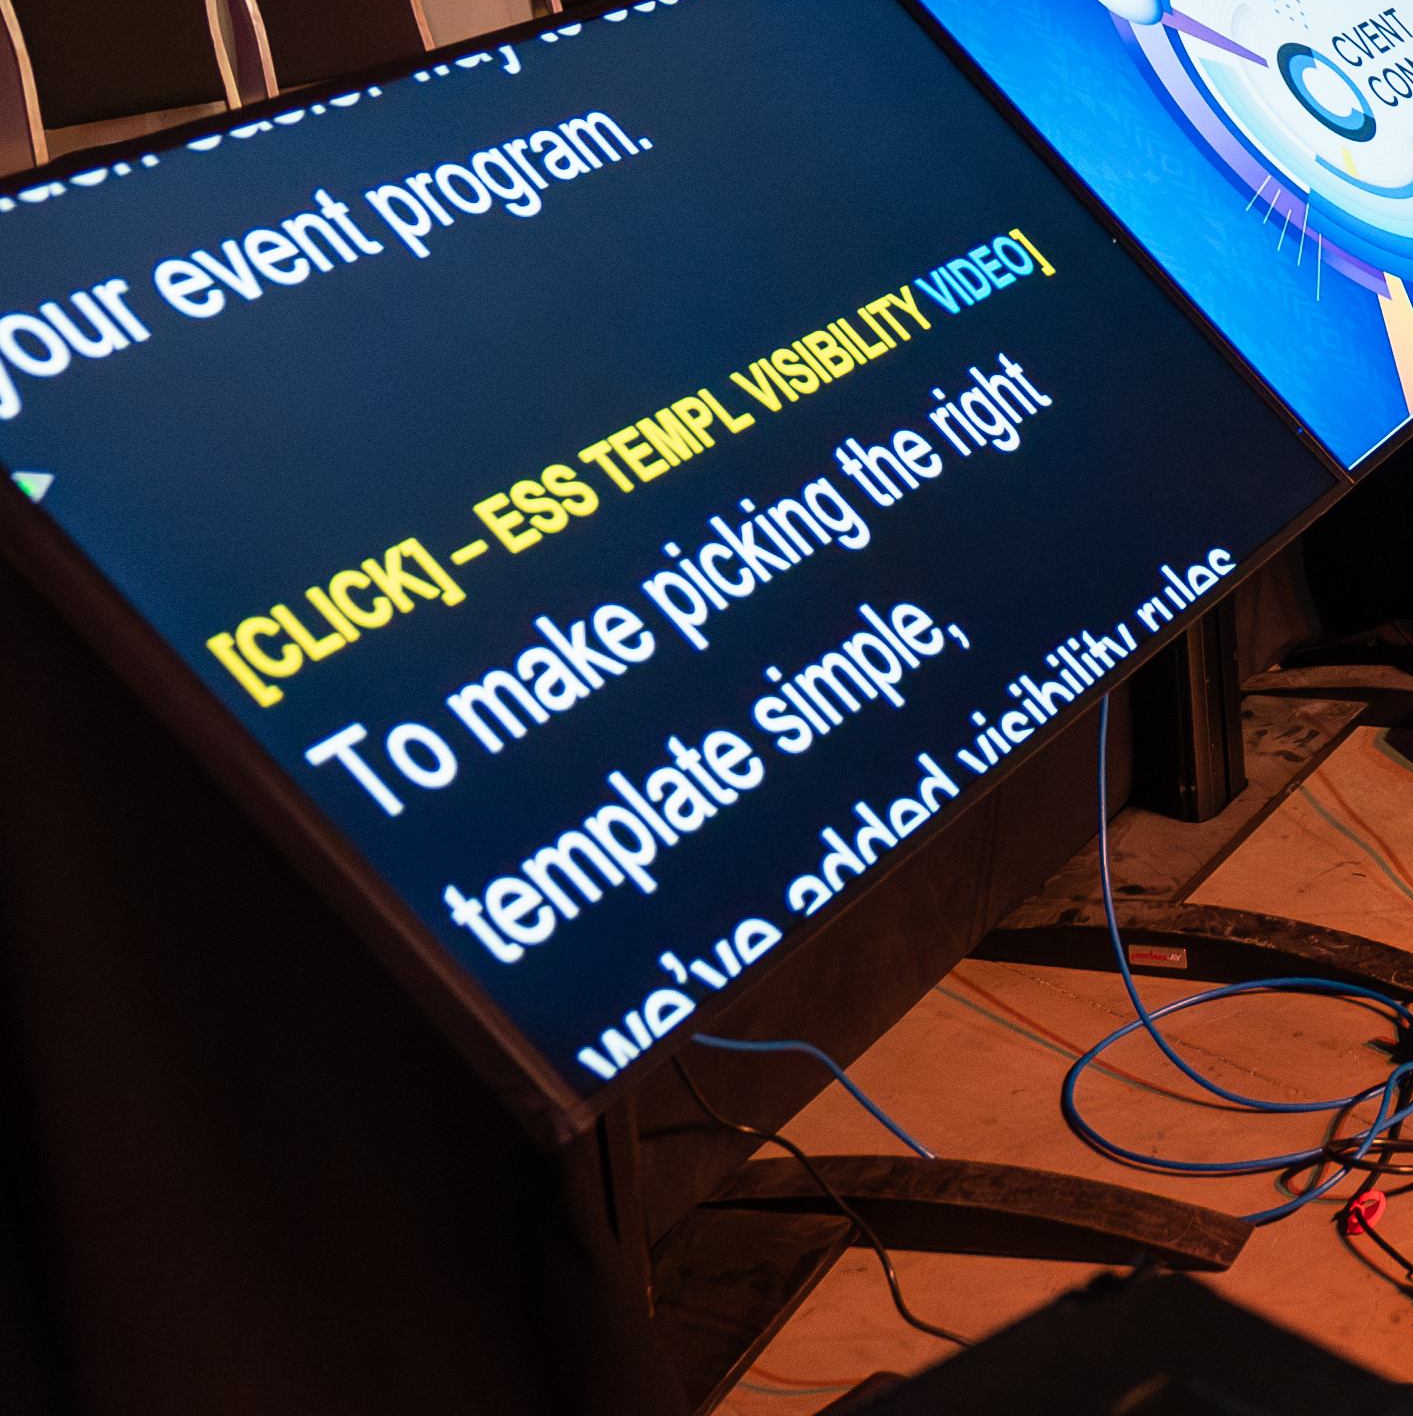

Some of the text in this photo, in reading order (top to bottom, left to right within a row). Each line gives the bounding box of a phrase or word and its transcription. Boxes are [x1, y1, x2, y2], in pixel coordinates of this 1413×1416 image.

[154, 188, 385, 319] event
[364, 111, 654, 259] program.
[1331, 7, 1413, 67] CVENT
[206, 537, 467, 708] [CLICK]
[472, 463, 600, 555] ESS
[577, 387, 756, 494] TEMPL
[728, 284, 932, 413] VISIBILITY
[914, 228, 1057, 315] VIDEO]
[304, 352, 1053, 817] To make picking the right
[443, 602, 970, 964] template simple,
